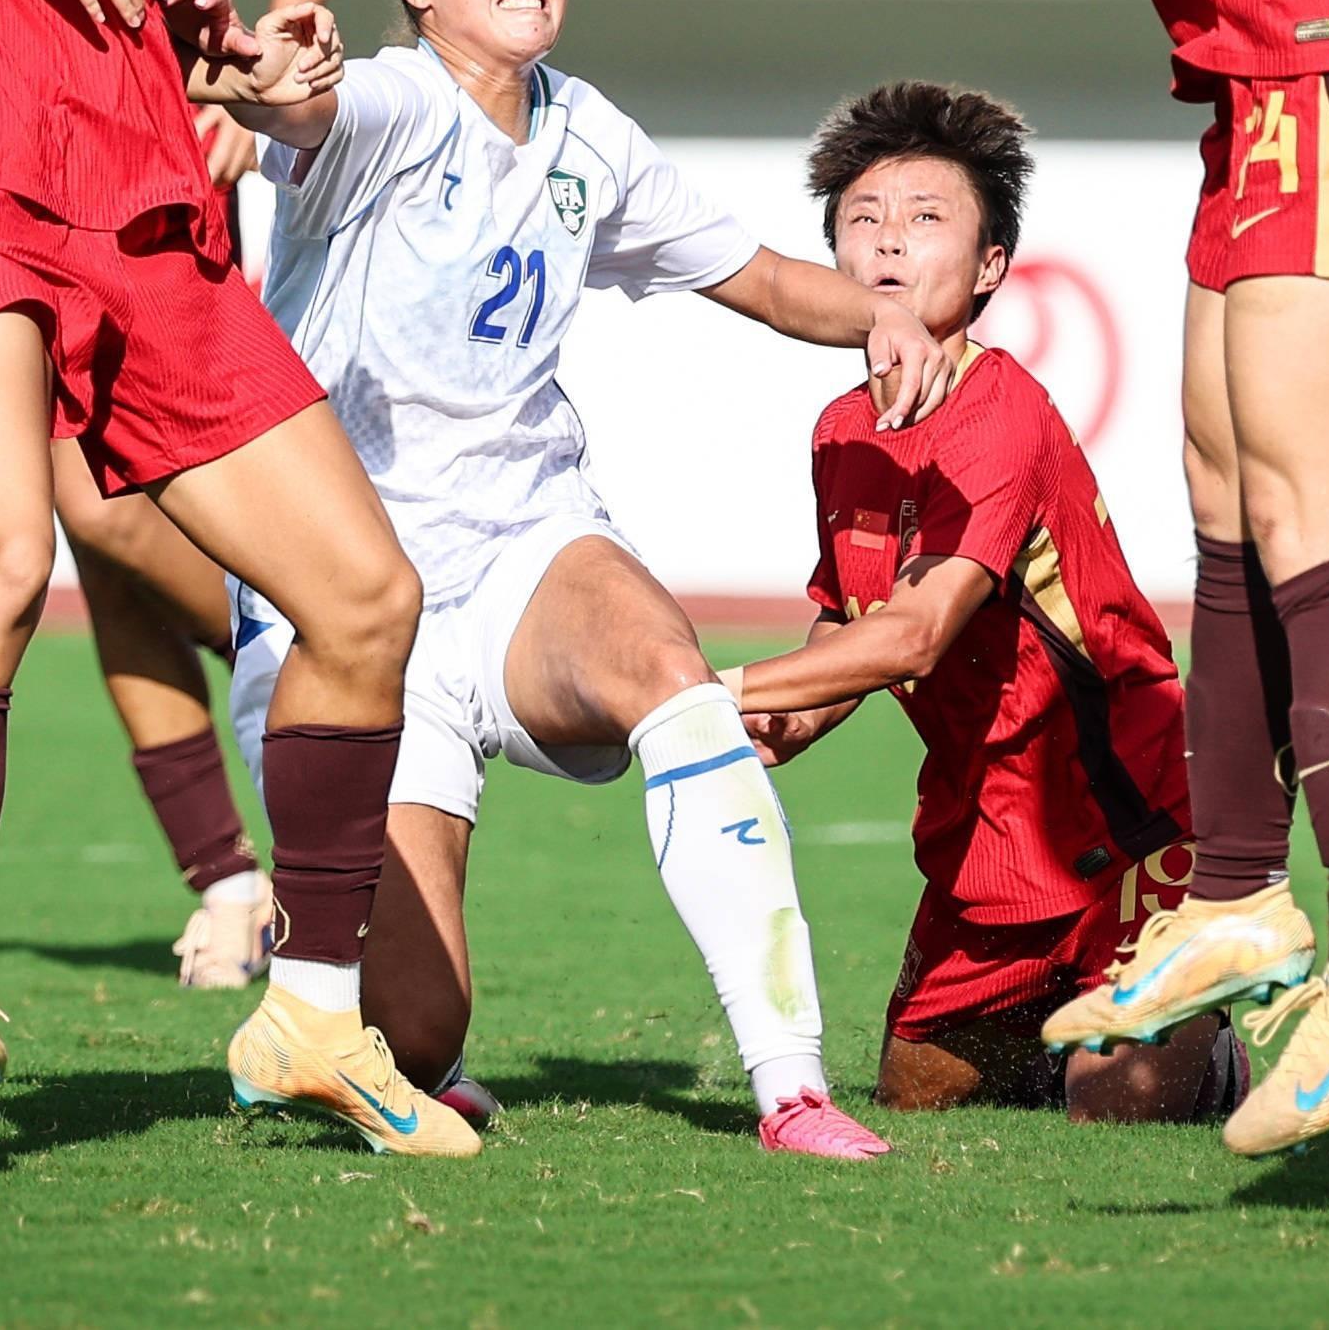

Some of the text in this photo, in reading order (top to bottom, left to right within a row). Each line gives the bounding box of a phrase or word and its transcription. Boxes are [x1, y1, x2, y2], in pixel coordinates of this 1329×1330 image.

[549, 180, 585, 207] UFA
[468, 245, 547, 349] 21
[1120, 841, 1198, 923] 19
